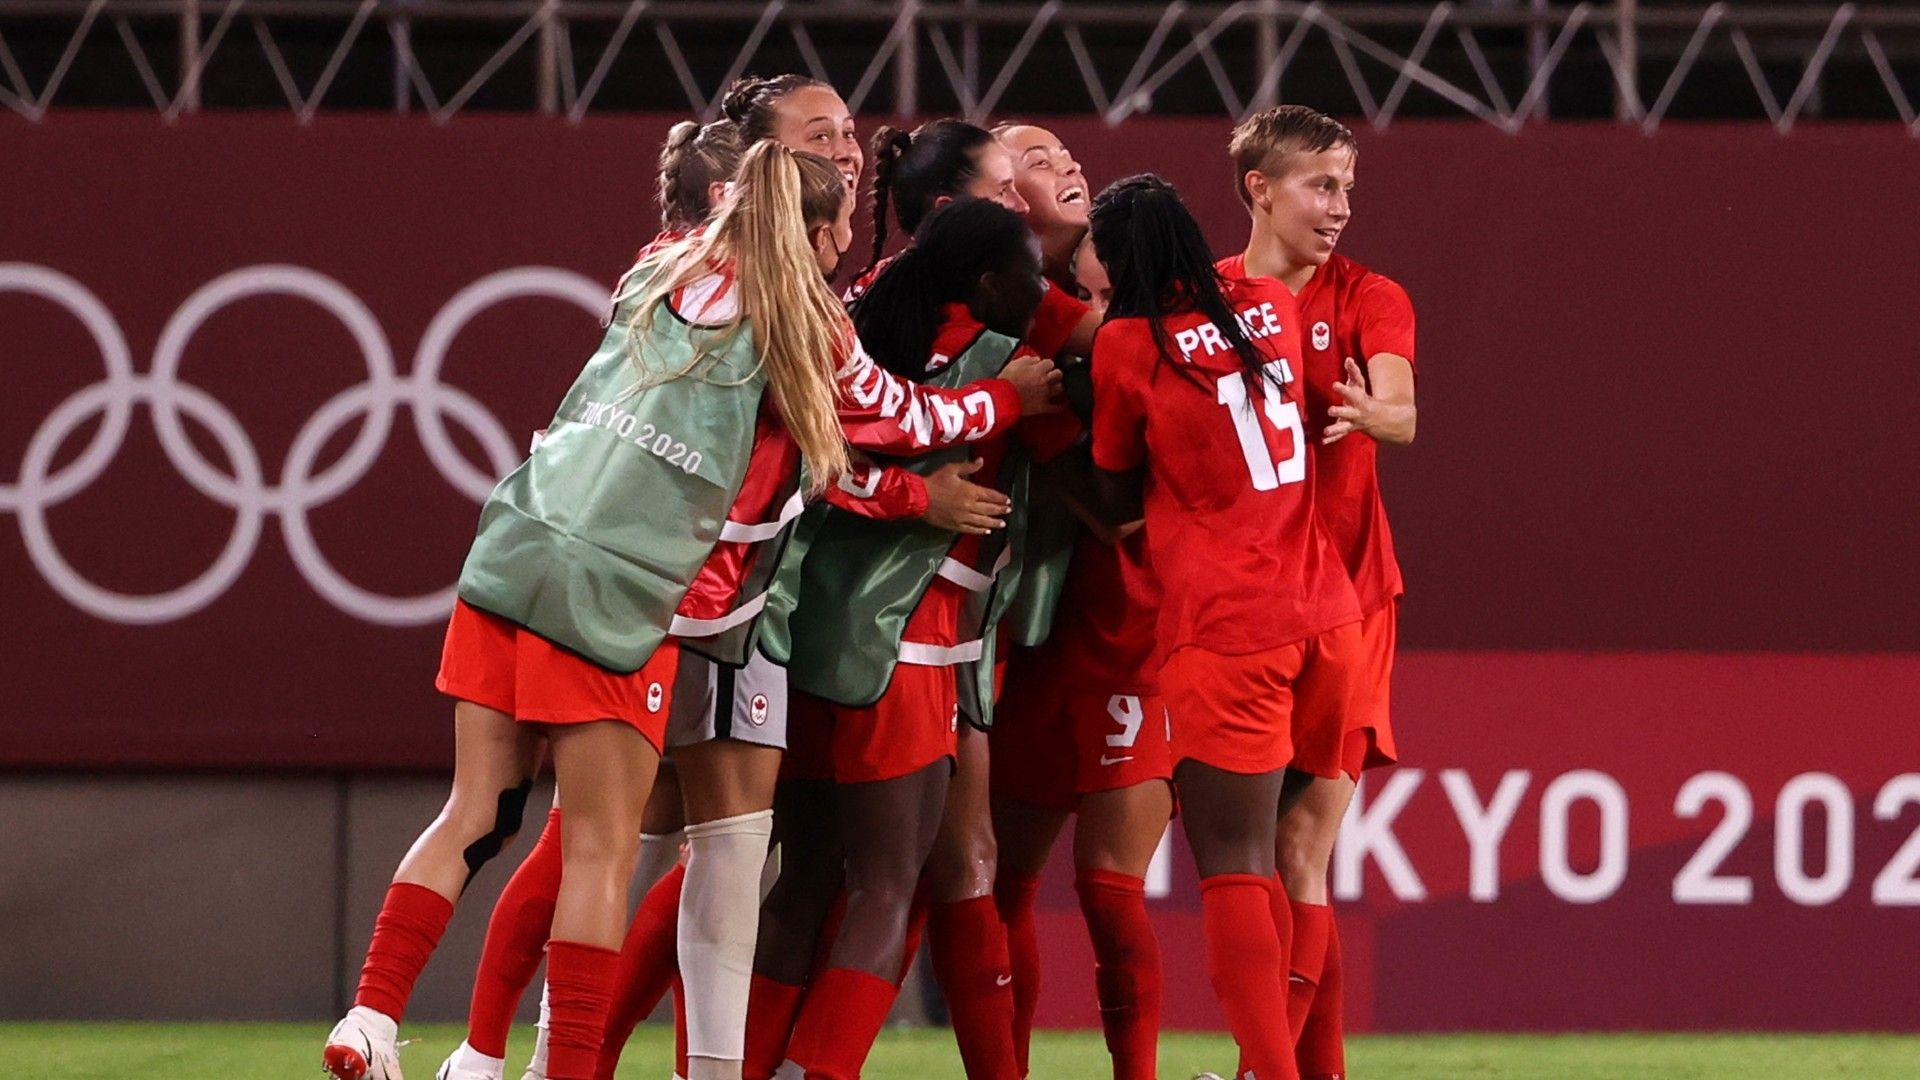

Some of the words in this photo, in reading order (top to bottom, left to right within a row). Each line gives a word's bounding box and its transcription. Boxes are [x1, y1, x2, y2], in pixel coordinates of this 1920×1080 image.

[1175, 302, 1282, 362] PRCE
[634, 423, 703, 474] 2020
[1217, 358, 1306, 491] 15
[1105, 694, 1144, 747] 9
[1143, 768, 1630, 905] KYO
